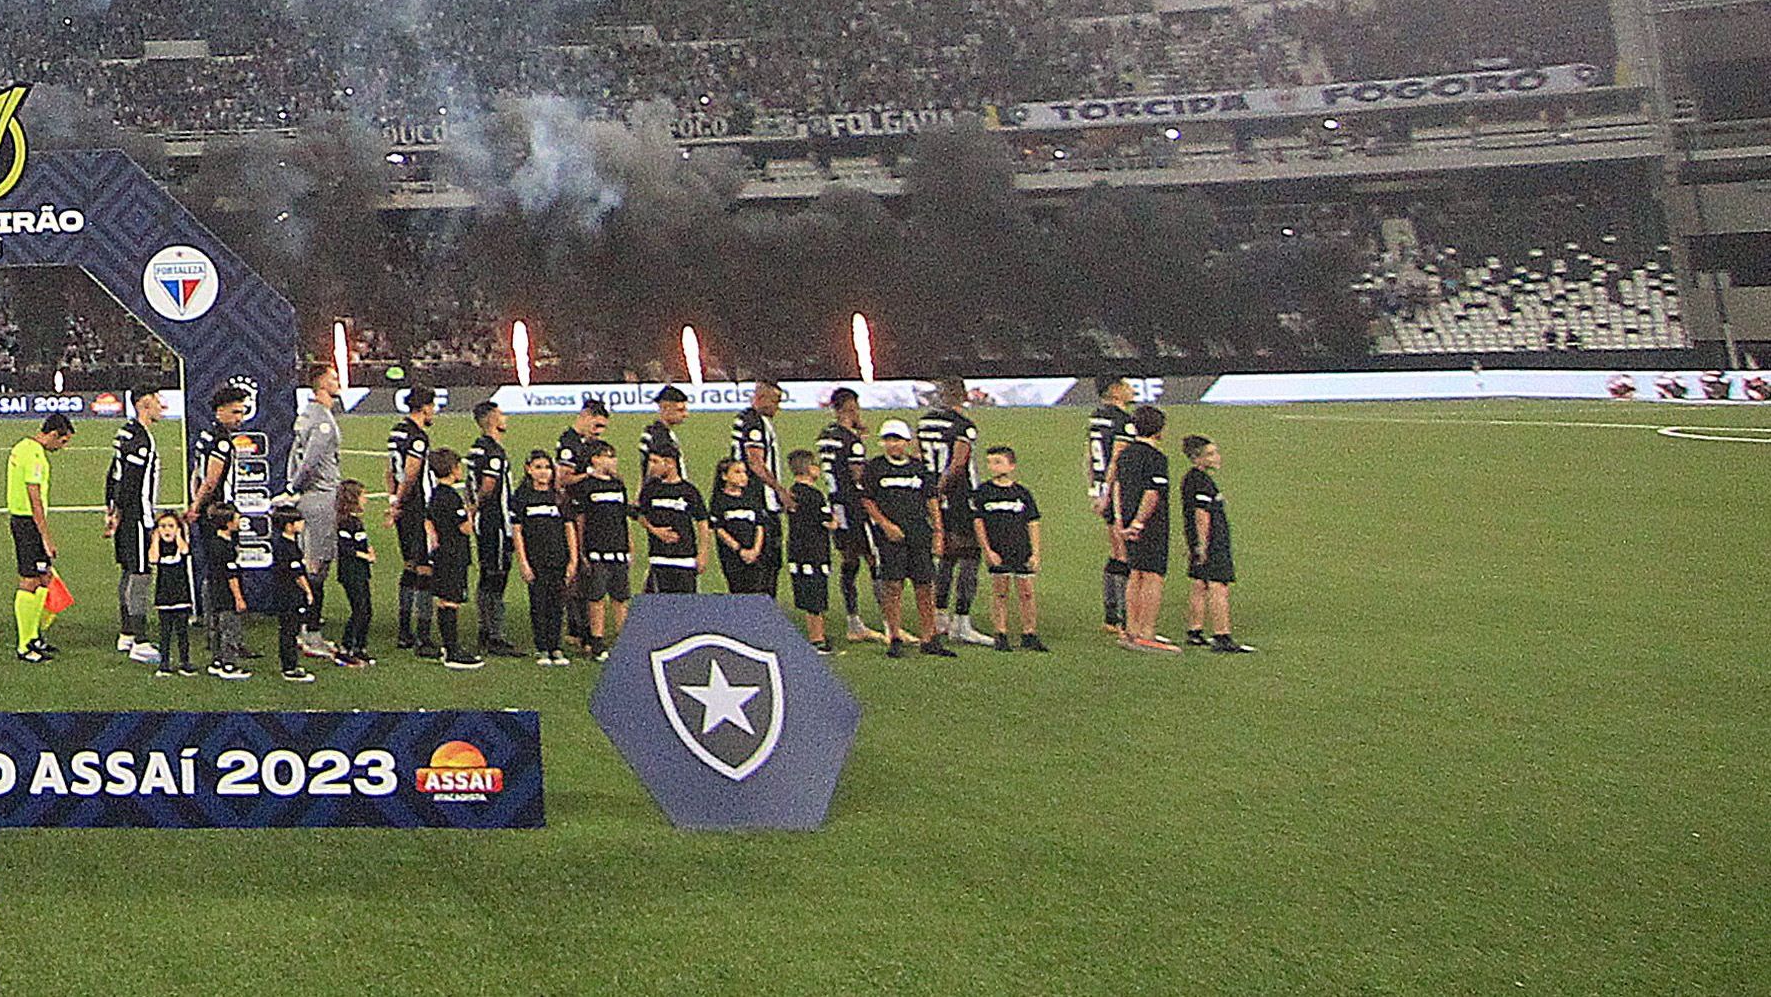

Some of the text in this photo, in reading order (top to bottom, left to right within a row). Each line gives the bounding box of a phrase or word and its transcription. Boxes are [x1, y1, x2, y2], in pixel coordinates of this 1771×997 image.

[1050, 94, 1250, 122] TORCIDA
[394, 387, 449, 413] CF
[523, 392, 576, 407] Vamos
[1123, 377, 1165, 403] BF
[33, 396, 84, 413] 2023
[215, 748, 398, 796] 2023
